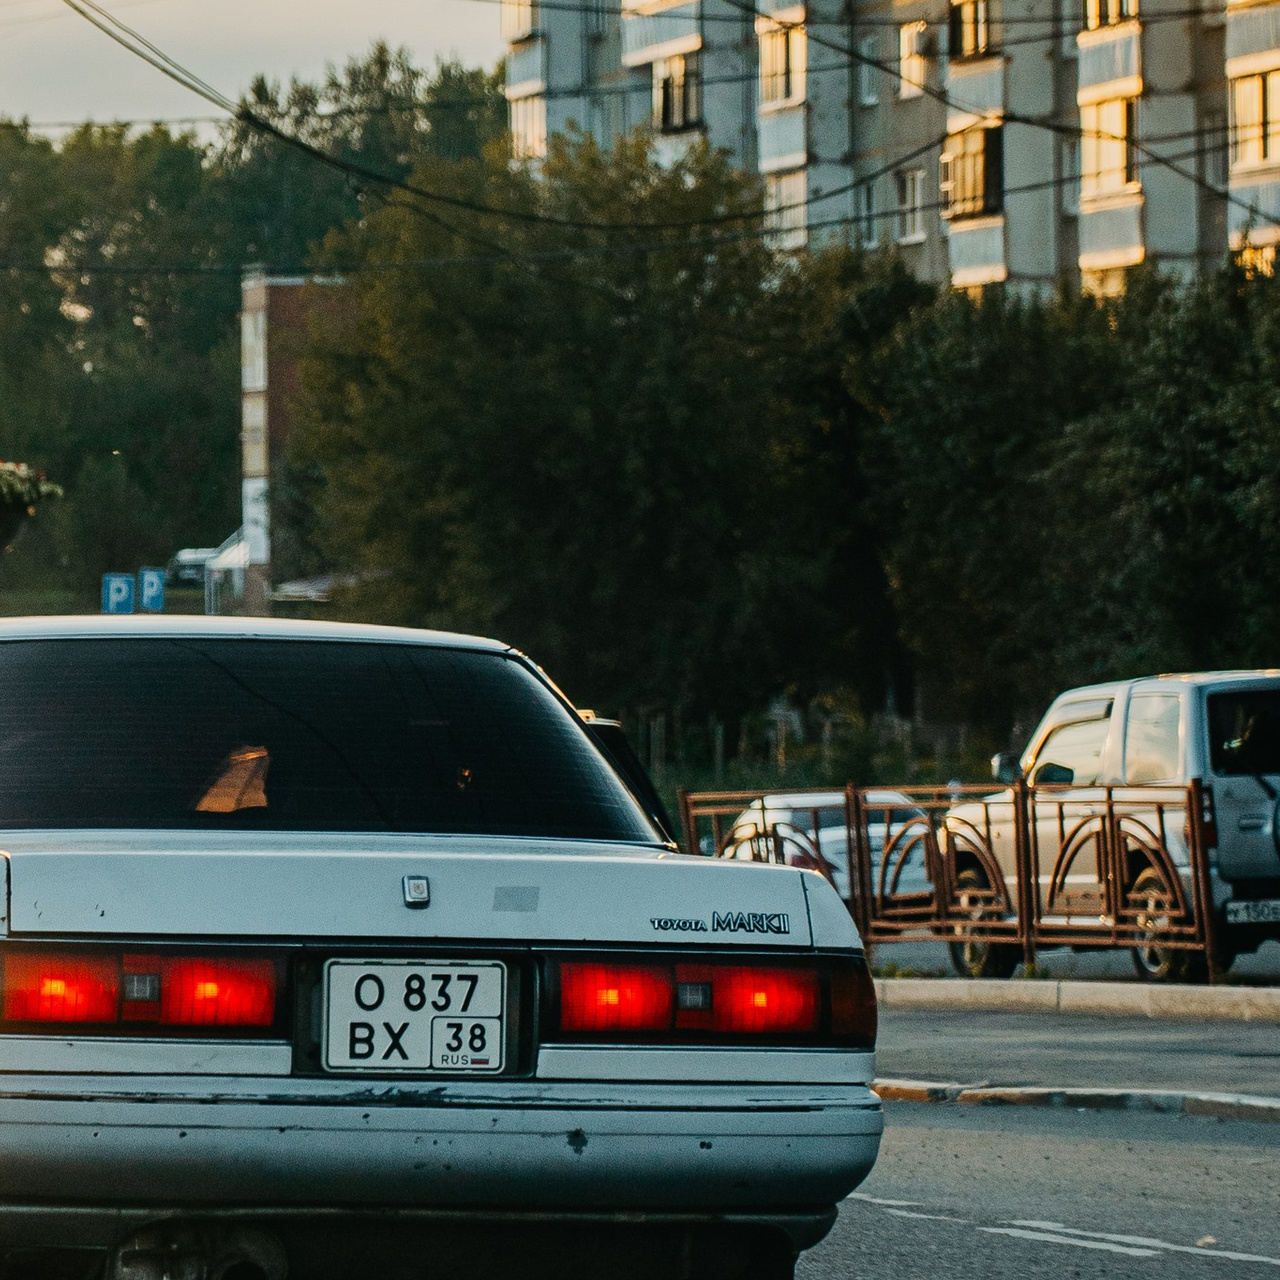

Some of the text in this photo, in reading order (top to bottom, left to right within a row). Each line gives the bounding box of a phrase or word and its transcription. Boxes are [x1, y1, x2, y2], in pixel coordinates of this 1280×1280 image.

[109, 579, 129, 613] P
[141, 570, 163, 608] P
[650, 918, 708, 932] TOYOTA
[403, 973, 479, 1012] 837
[445, 1023, 486, 1053] 38
[441, 1054, 469, 1065] RUS
